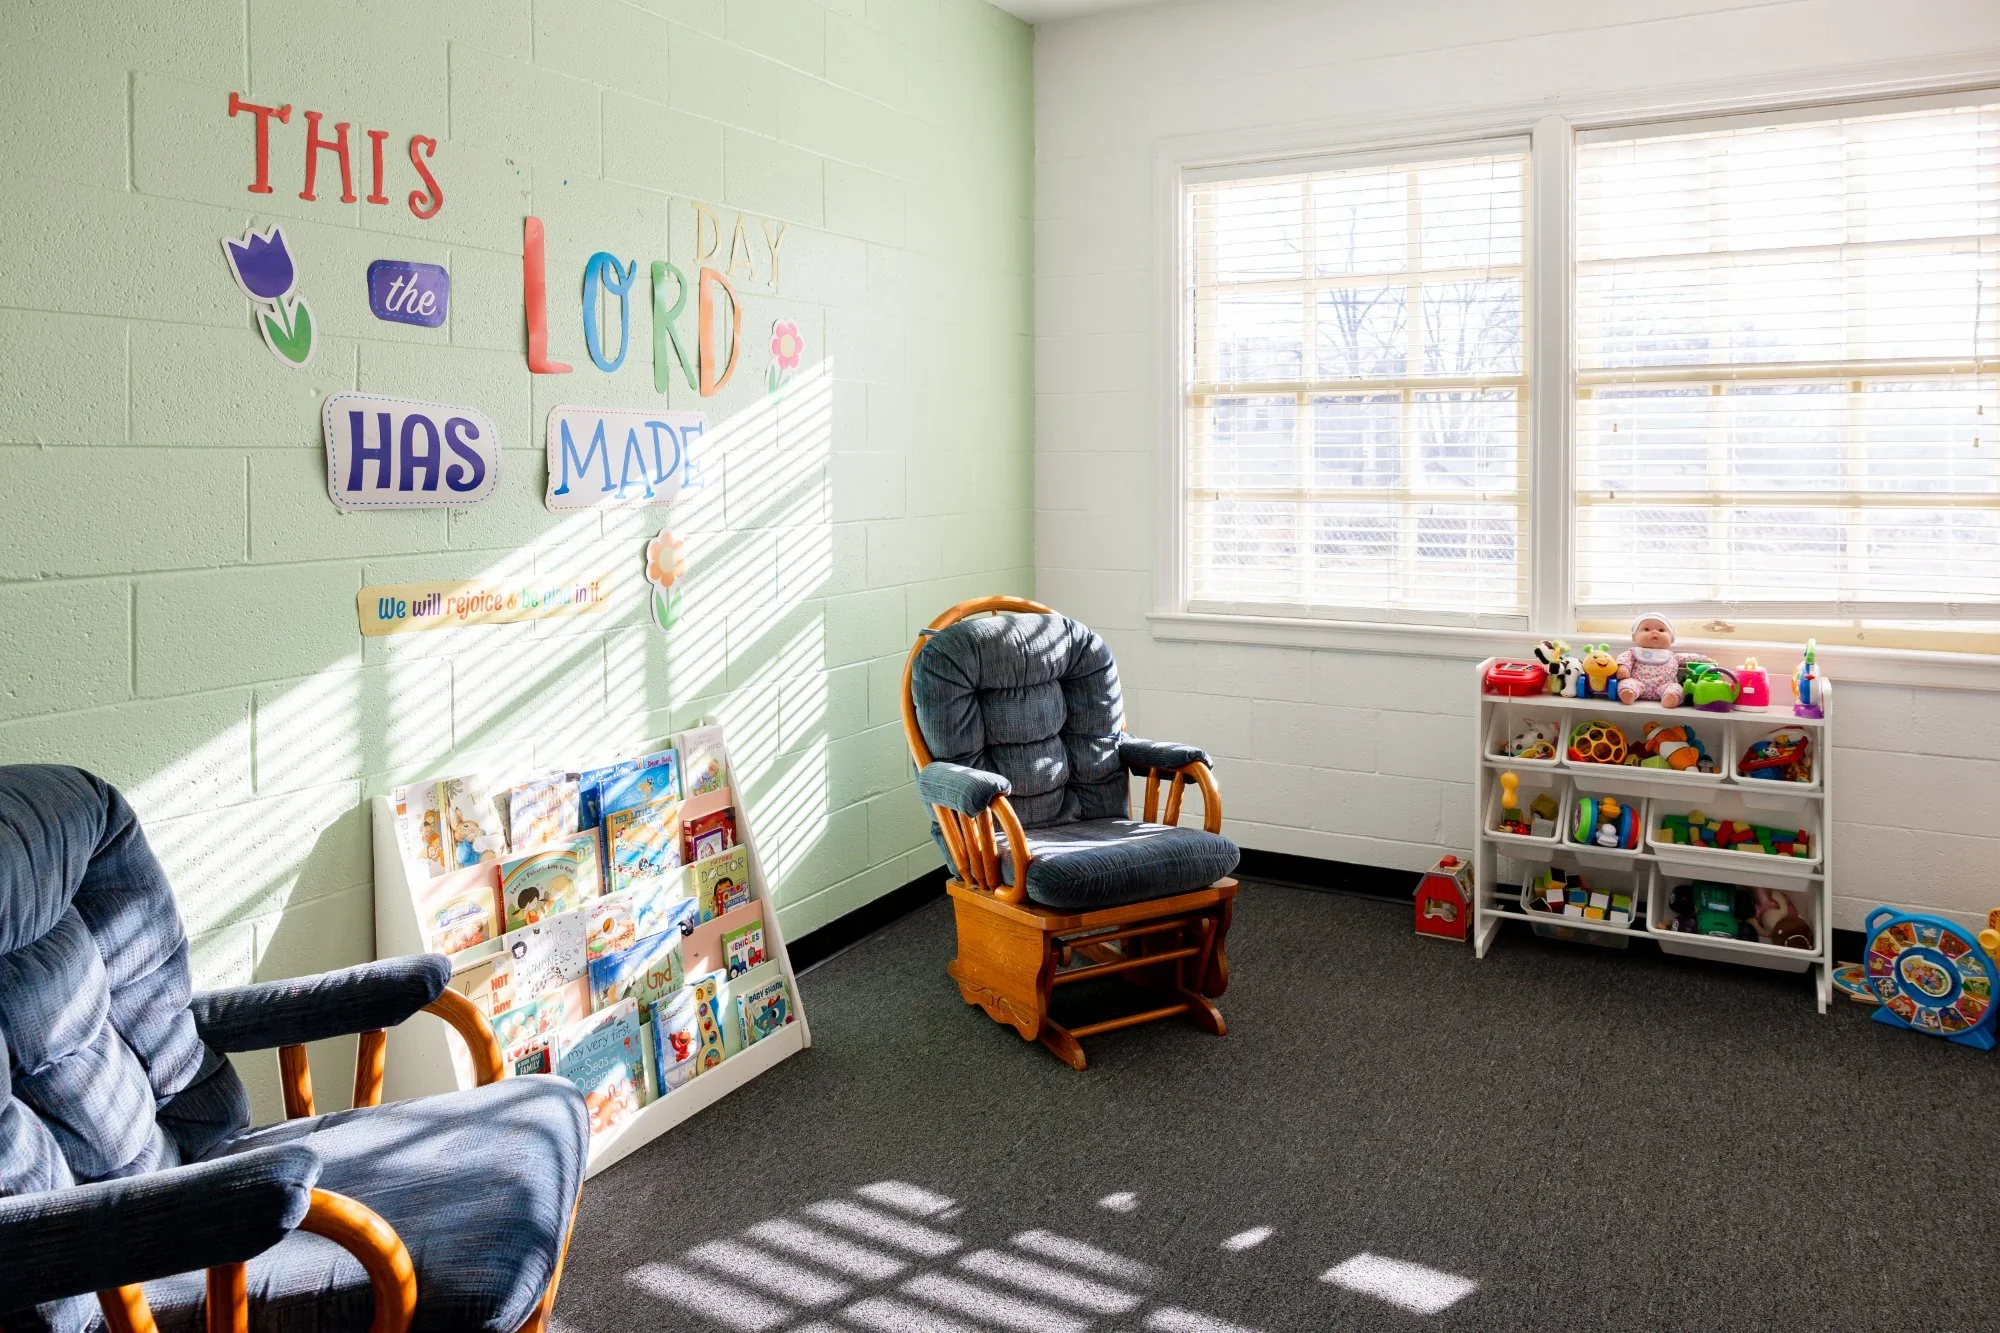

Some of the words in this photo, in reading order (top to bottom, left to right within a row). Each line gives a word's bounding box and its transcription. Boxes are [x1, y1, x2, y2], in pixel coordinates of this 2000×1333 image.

[228, 92, 443, 219] THIS
[691, 201, 790, 287] DAY
[385, 272, 437, 316] the
[522, 215, 742, 398] LORD
[346, 410, 486, 493] HAS
[554, 418, 704, 500] MADE
[378, 597, 406, 620] We
[412, 593, 441, 617] will
[446, 590, 503, 620] rejoice
[506, 597, 517, 610] &
[521, 587, 539, 609] be
[543, 587, 571, 611] glad
[575, 583, 587, 604] in
[590, 581, 603, 602] it.
[647, 760, 659, 768] Dear
[701, 857, 744, 883] DOCTOR
[709, 853, 733, 866] FUTURE
[510, 881, 522, 895] Love
[591, 909, 604, 920] Taco
[605, 904, 627, 913] Tuesday
[730, 932, 760, 952] VEHICLES
[490, 973, 509, 991] NOT
[646, 954, 673, 990] God
[492, 991, 500, 1004] A
[748, 988, 764, 1004] BABY
[764, 980, 784, 996] SHARK
[567, 1049, 584, 1062] my
[586, 1036, 609, 1053] very
[612, 1022, 632, 1041] first
[520, 1060, 541, 1076] FAMILY
[585, 1056, 609, 1075] Seas
